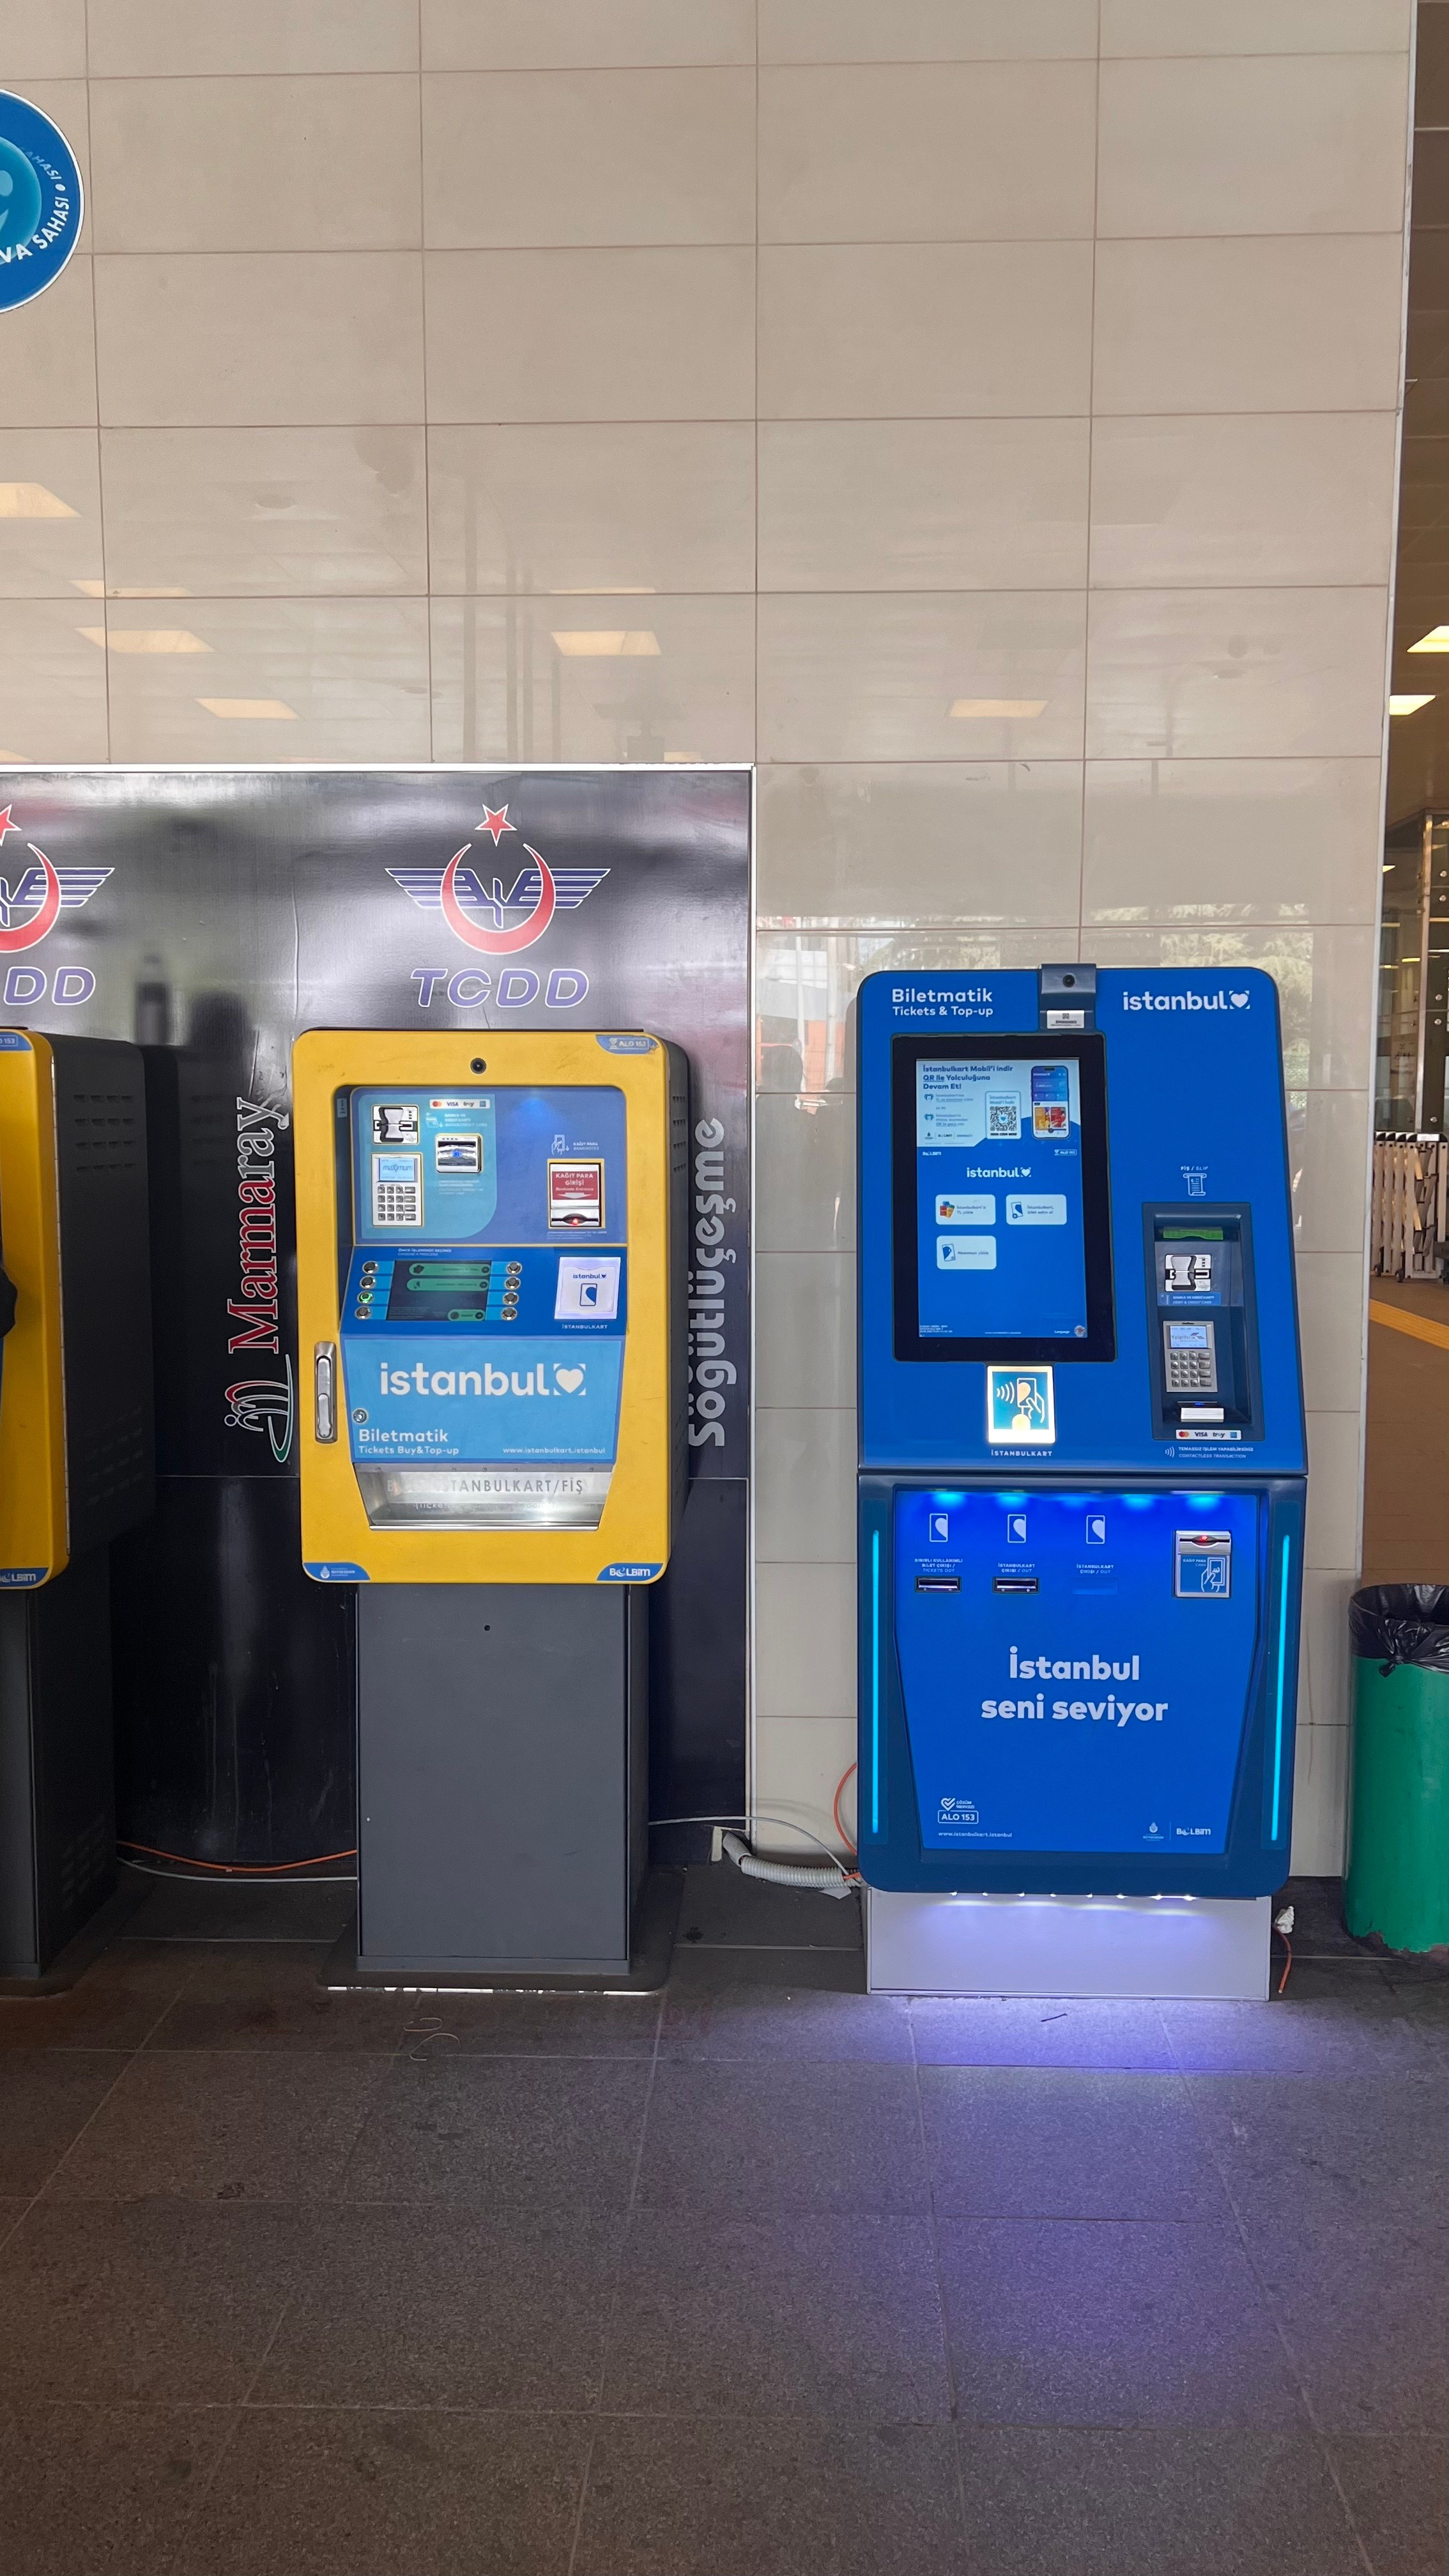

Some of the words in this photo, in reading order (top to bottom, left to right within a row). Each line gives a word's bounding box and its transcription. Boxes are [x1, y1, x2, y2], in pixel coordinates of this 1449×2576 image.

[32, 197, 70, 249] SAHASI
[410, 968, 589, 1008] TCDD
[892, 988, 993, 1002] Biletmatik
[1123, 991, 1228, 1010] istanbul
[893, 1006, 935, 1015] Tickets
[939, 1006, 947, 1015] &
[951, 1006, 993, 1017] Top-up
[923, 1064, 969, 1072] İstanbulkart
[967, 1167, 1020, 1178] istanbul
[227, 1097, 289, 1354] Marmaray
[688, 1118, 737, 1447] Söğütlüçeşme
[380, 1362, 551, 1396] istanbul
[359, 1429, 448, 1442] Biletmatik
[358, 1446, 395, 1454] Tickets
[397, 1446, 459, 1456] Buy&Top-up
[1009, 1646, 1140, 1681] İstanbul
[981, 1693, 1044, 1719] seni
[1052, 1694, 1169, 1727] seviyor
